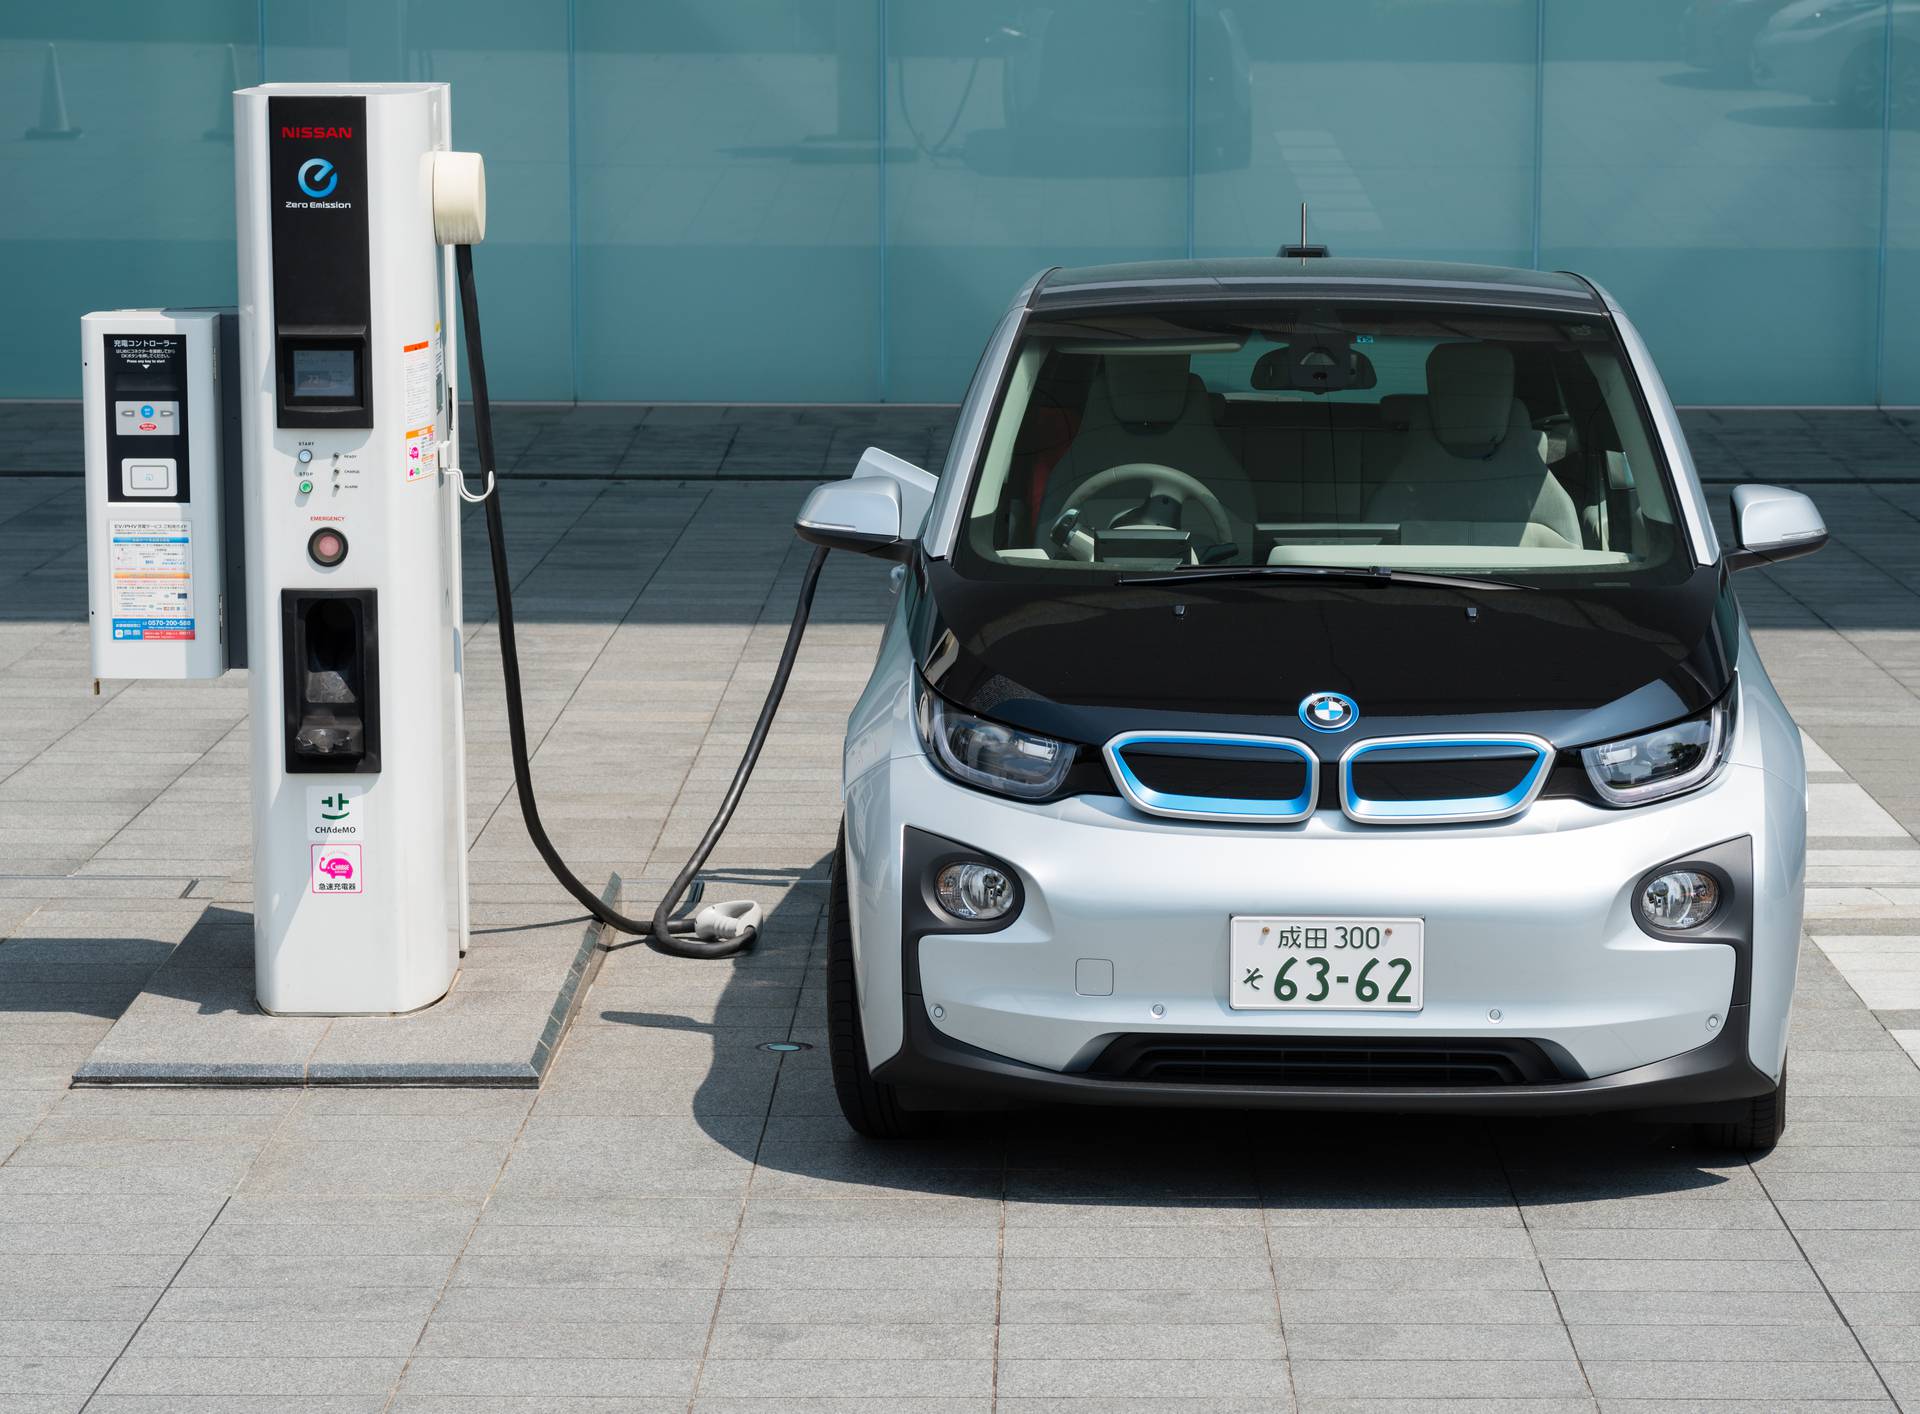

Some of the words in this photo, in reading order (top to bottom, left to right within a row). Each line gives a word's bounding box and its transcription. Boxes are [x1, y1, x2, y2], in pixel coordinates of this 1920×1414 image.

[281, 126, 353, 140] NISSAN
[285, 201, 308, 209] Zero
[309, 201, 352, 209] Emission
[114, 339, 178, 348] 充電コントローラー
[314, 826, 357, 834] CHAdeMO
[318, 882, 357, 891] 急速充電器
[1277, 925, 1329, 950] 成田
[1333, 926, 1381, 949] 300
[1242, 966, 1265, 991] そ
[1273, 955, 1413, 1003] 63-62
